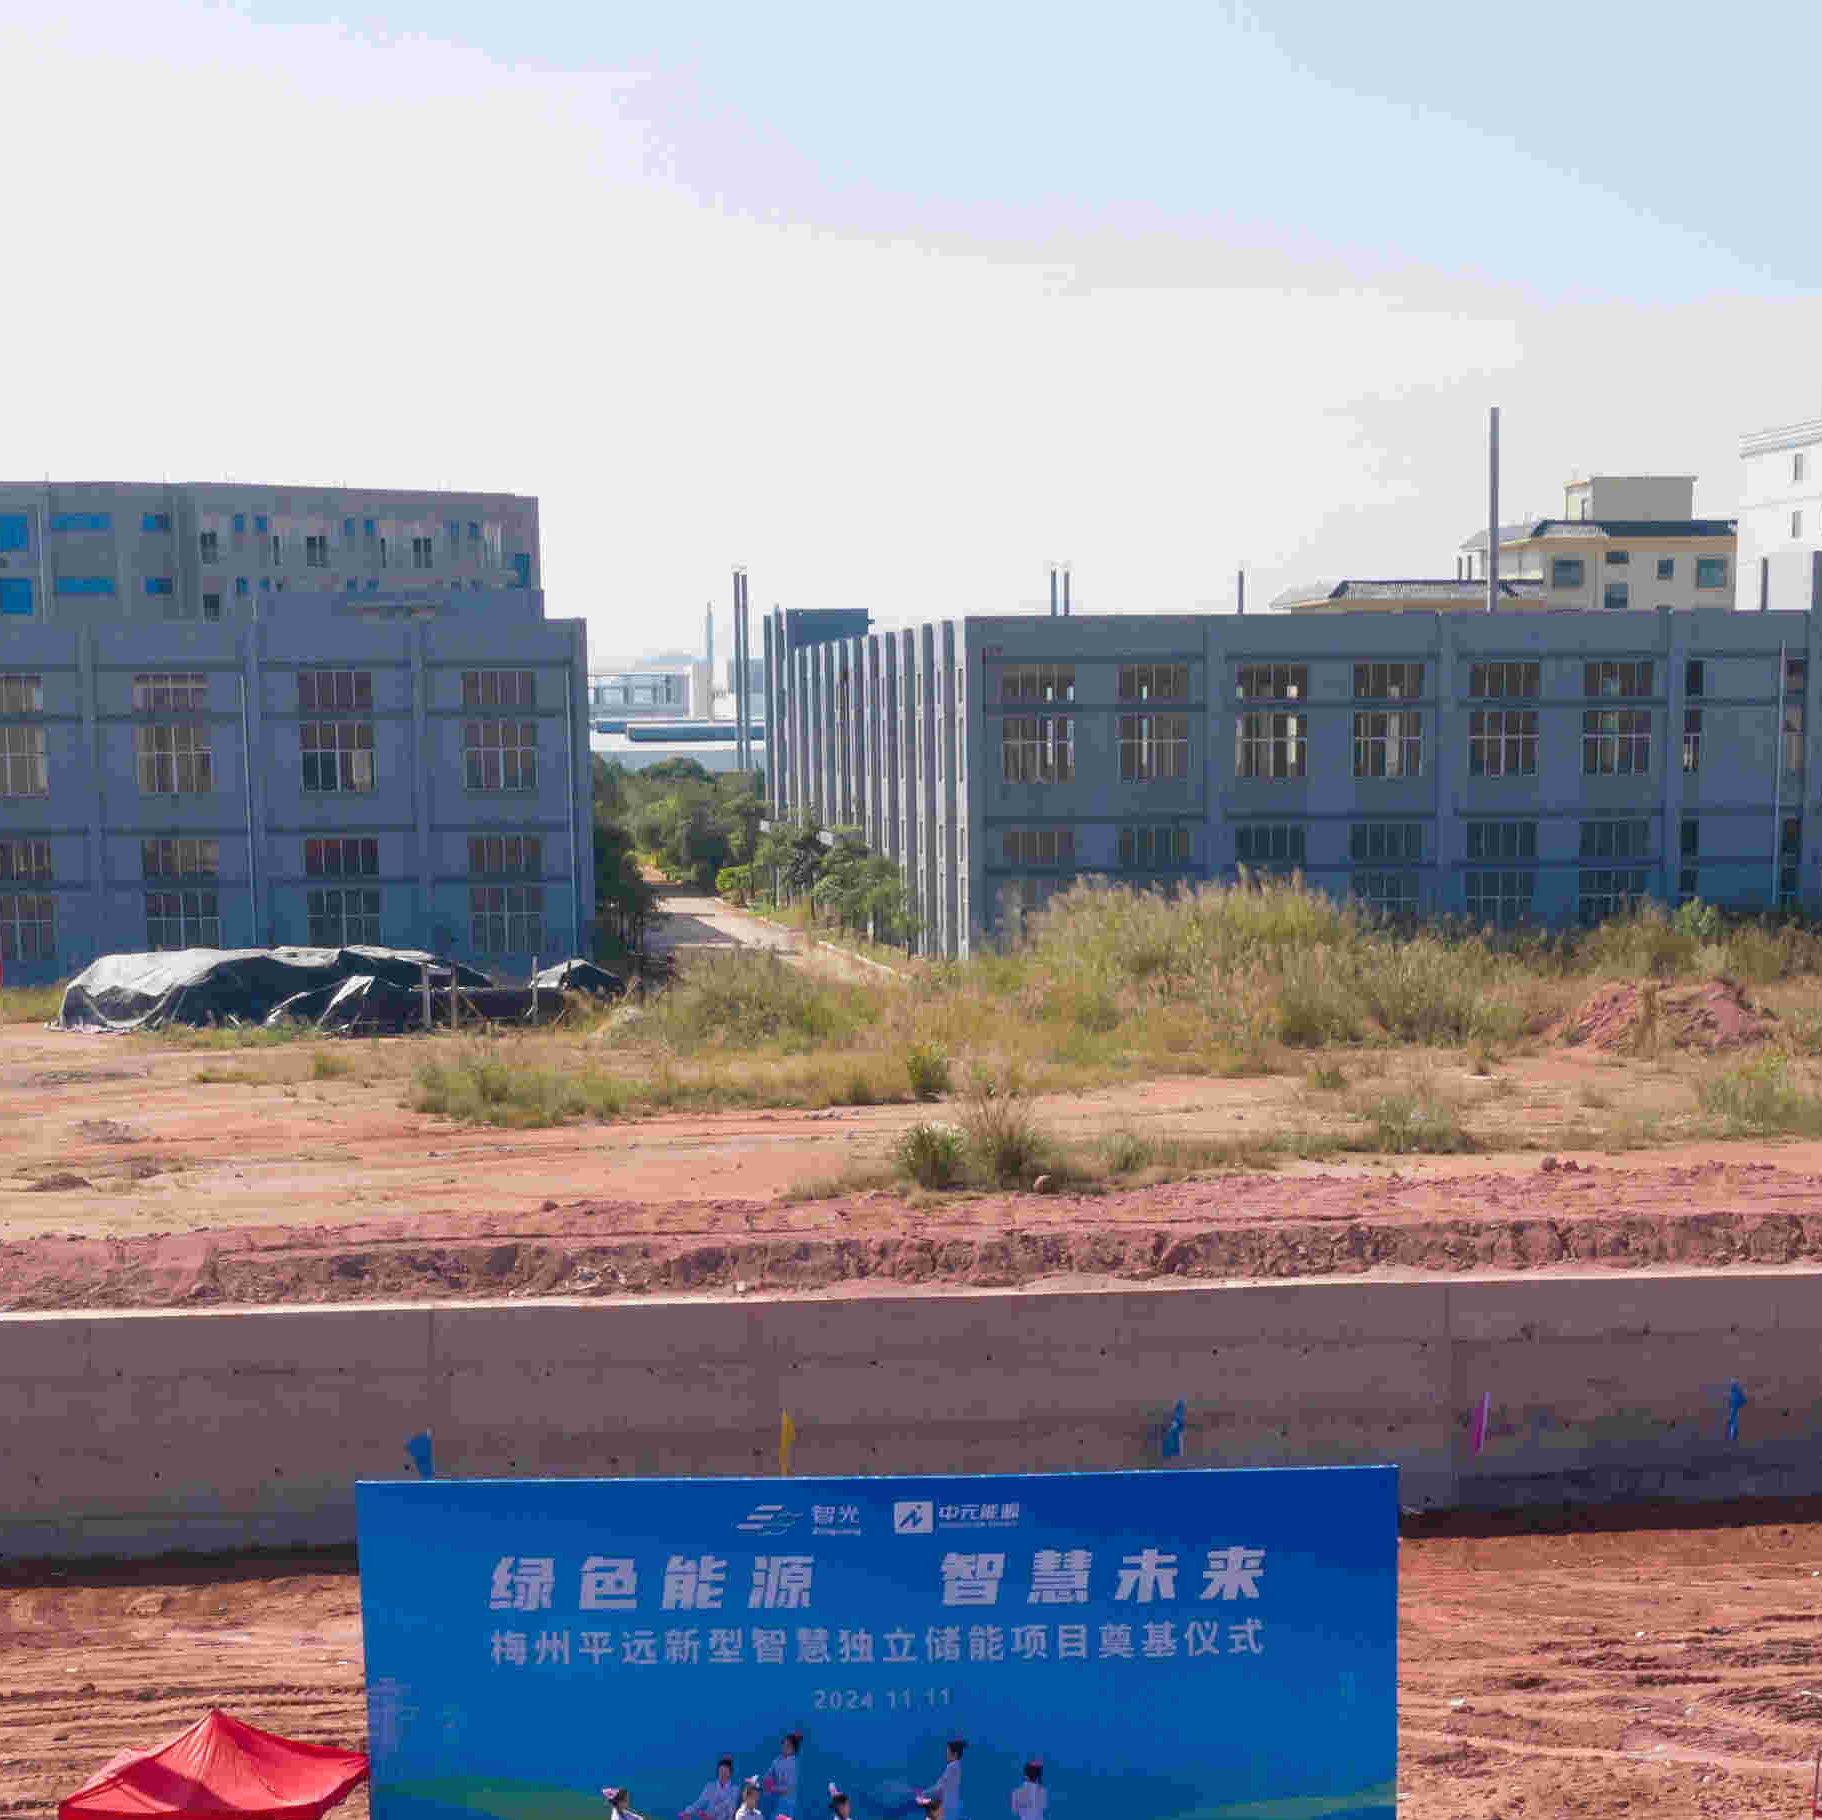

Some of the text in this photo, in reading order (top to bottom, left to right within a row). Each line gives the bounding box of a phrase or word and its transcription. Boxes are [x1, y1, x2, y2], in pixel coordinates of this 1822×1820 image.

[489, 1546, 1267, 1611] 绿色能源 智慧未来
[490, 1618, 1266, 1667] 梅州平远新型智慧独立储能项目奠基仪式
